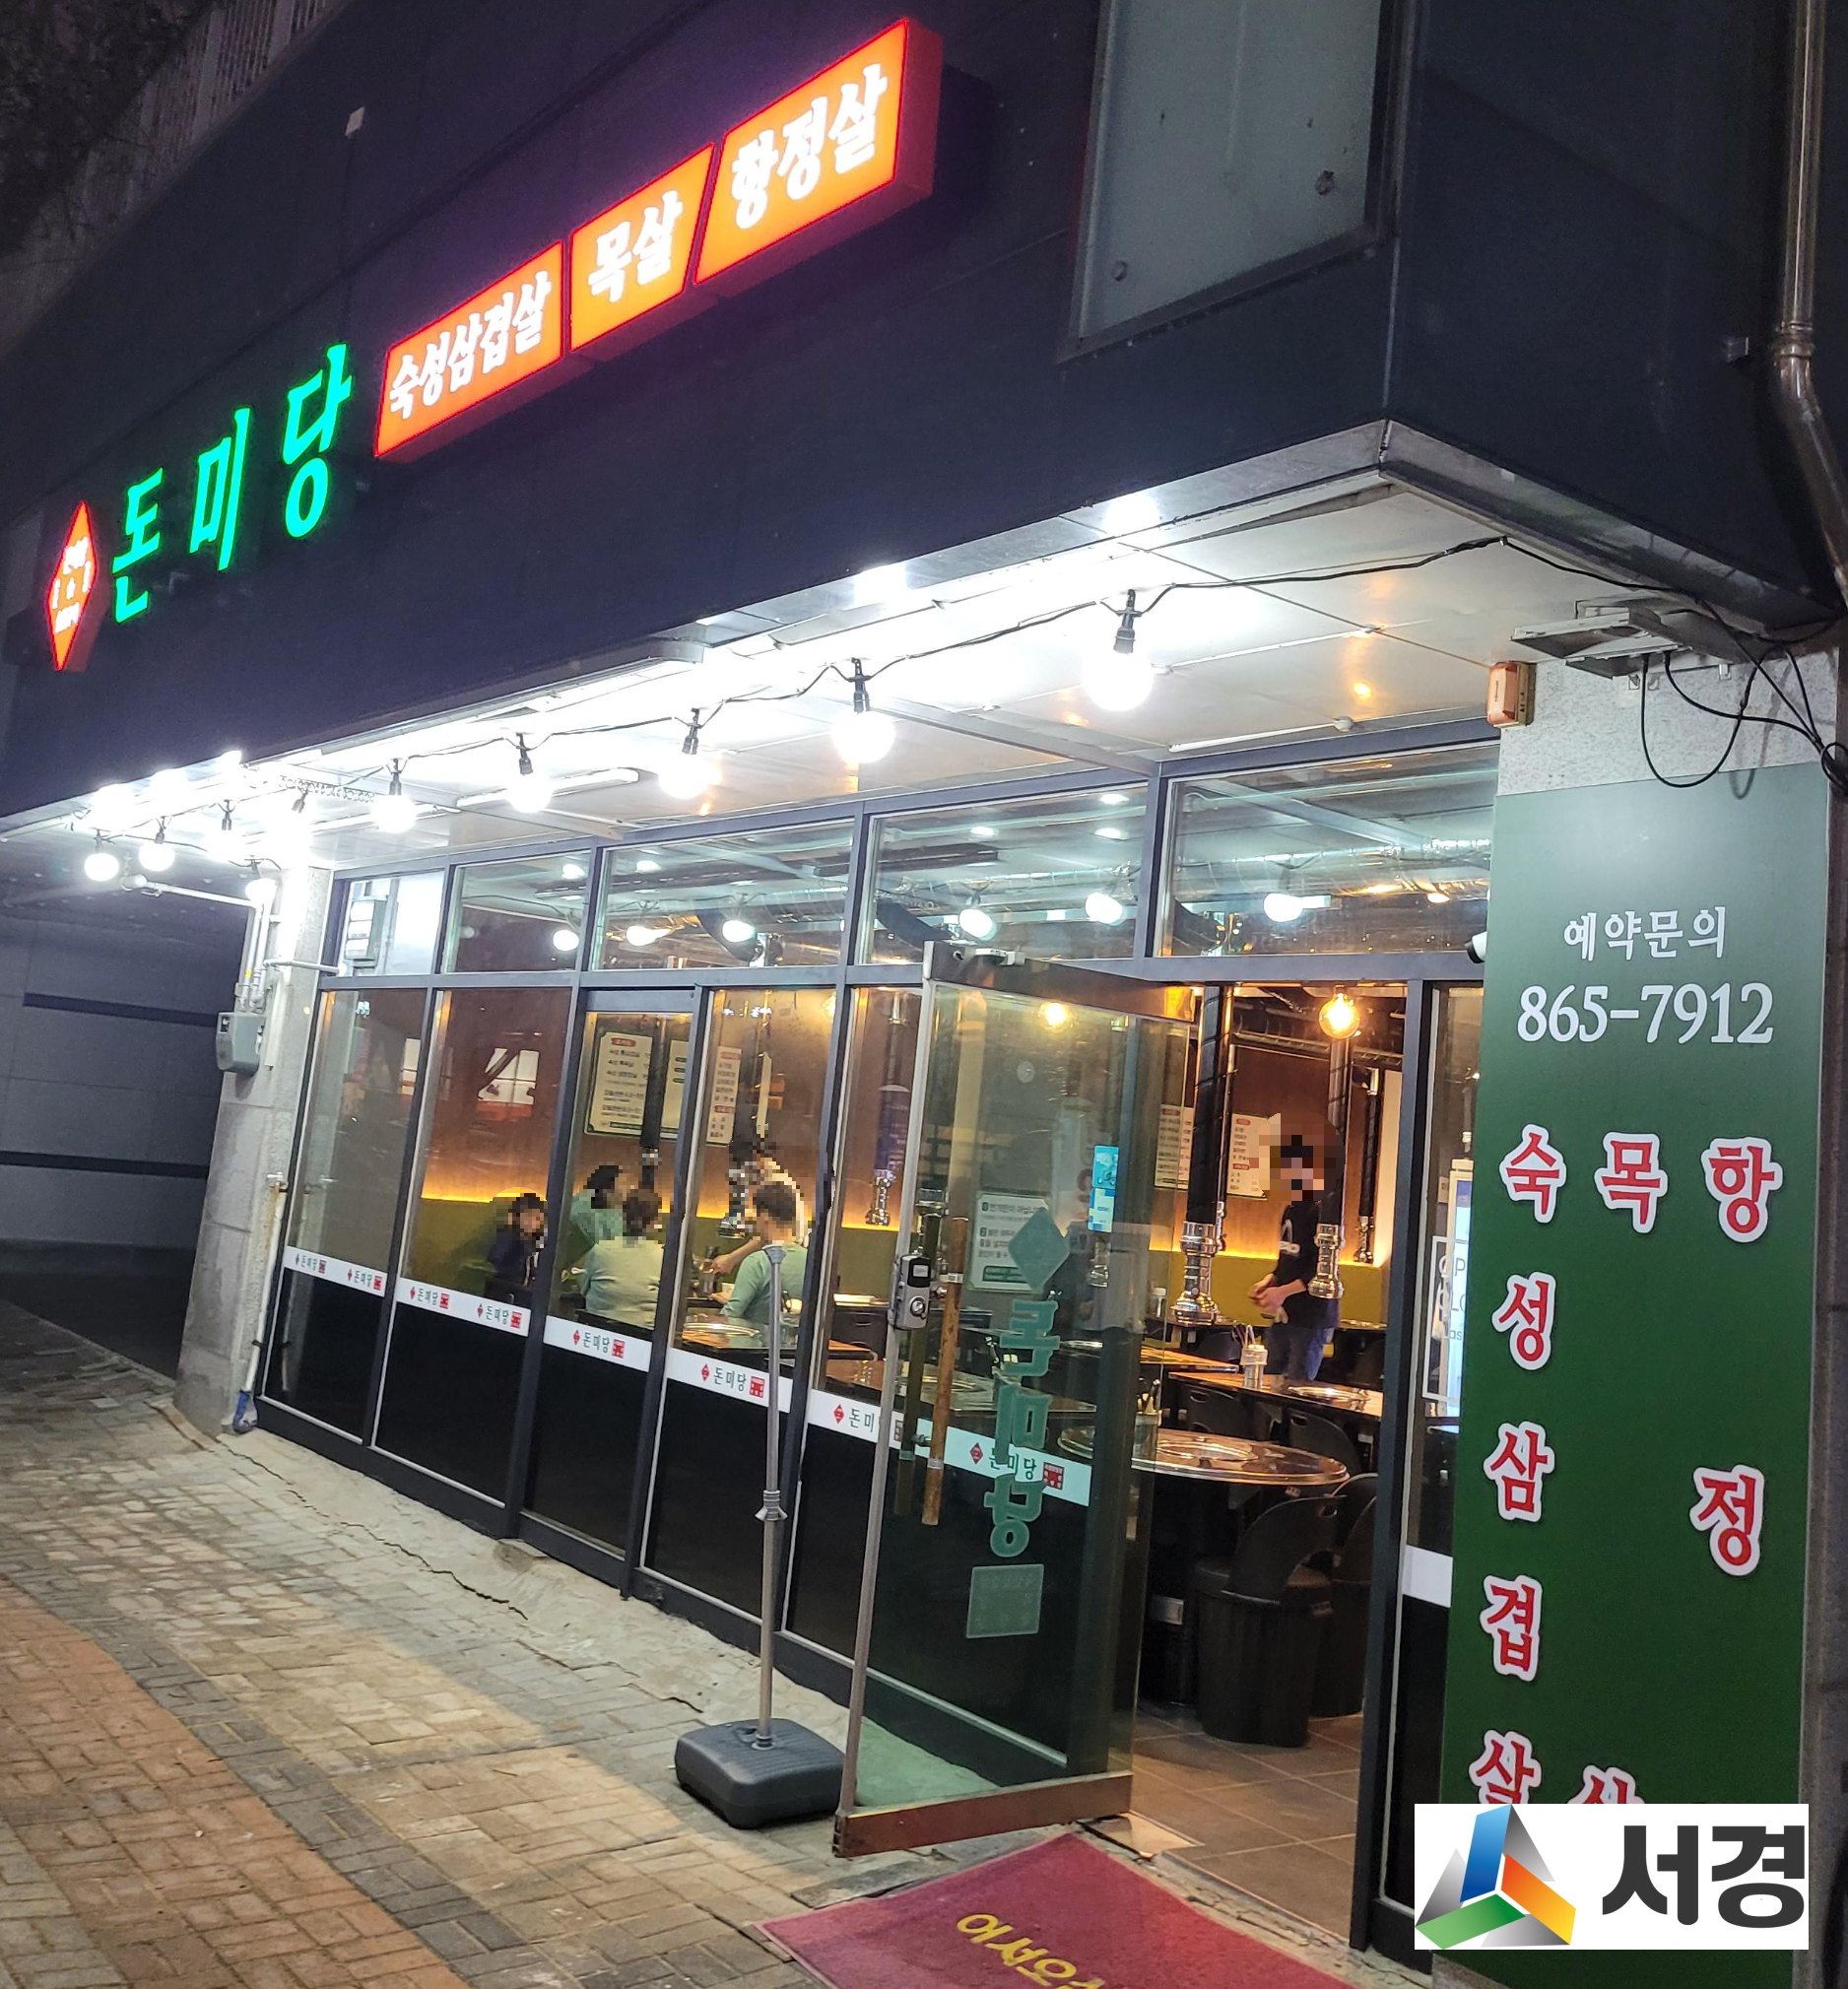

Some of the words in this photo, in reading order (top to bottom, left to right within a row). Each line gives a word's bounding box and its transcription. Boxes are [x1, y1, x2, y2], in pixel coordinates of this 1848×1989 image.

[731, 63, 888, 230] 항정살
[587, 190, 684, 303] 목살
[389, 270, 552, 420] 숙성삼겹살
[112, 343, 353, 624] 돈미당
[1564, 906, 1726, 961] 예약문의
[1517, 982, 1774, 1044] 865-7912
[583, 1331, 611, 1354] 돈미당
[713, 1366, 747, 1392] 돈미당
[848, 1408, 875, 1433] 돈미
